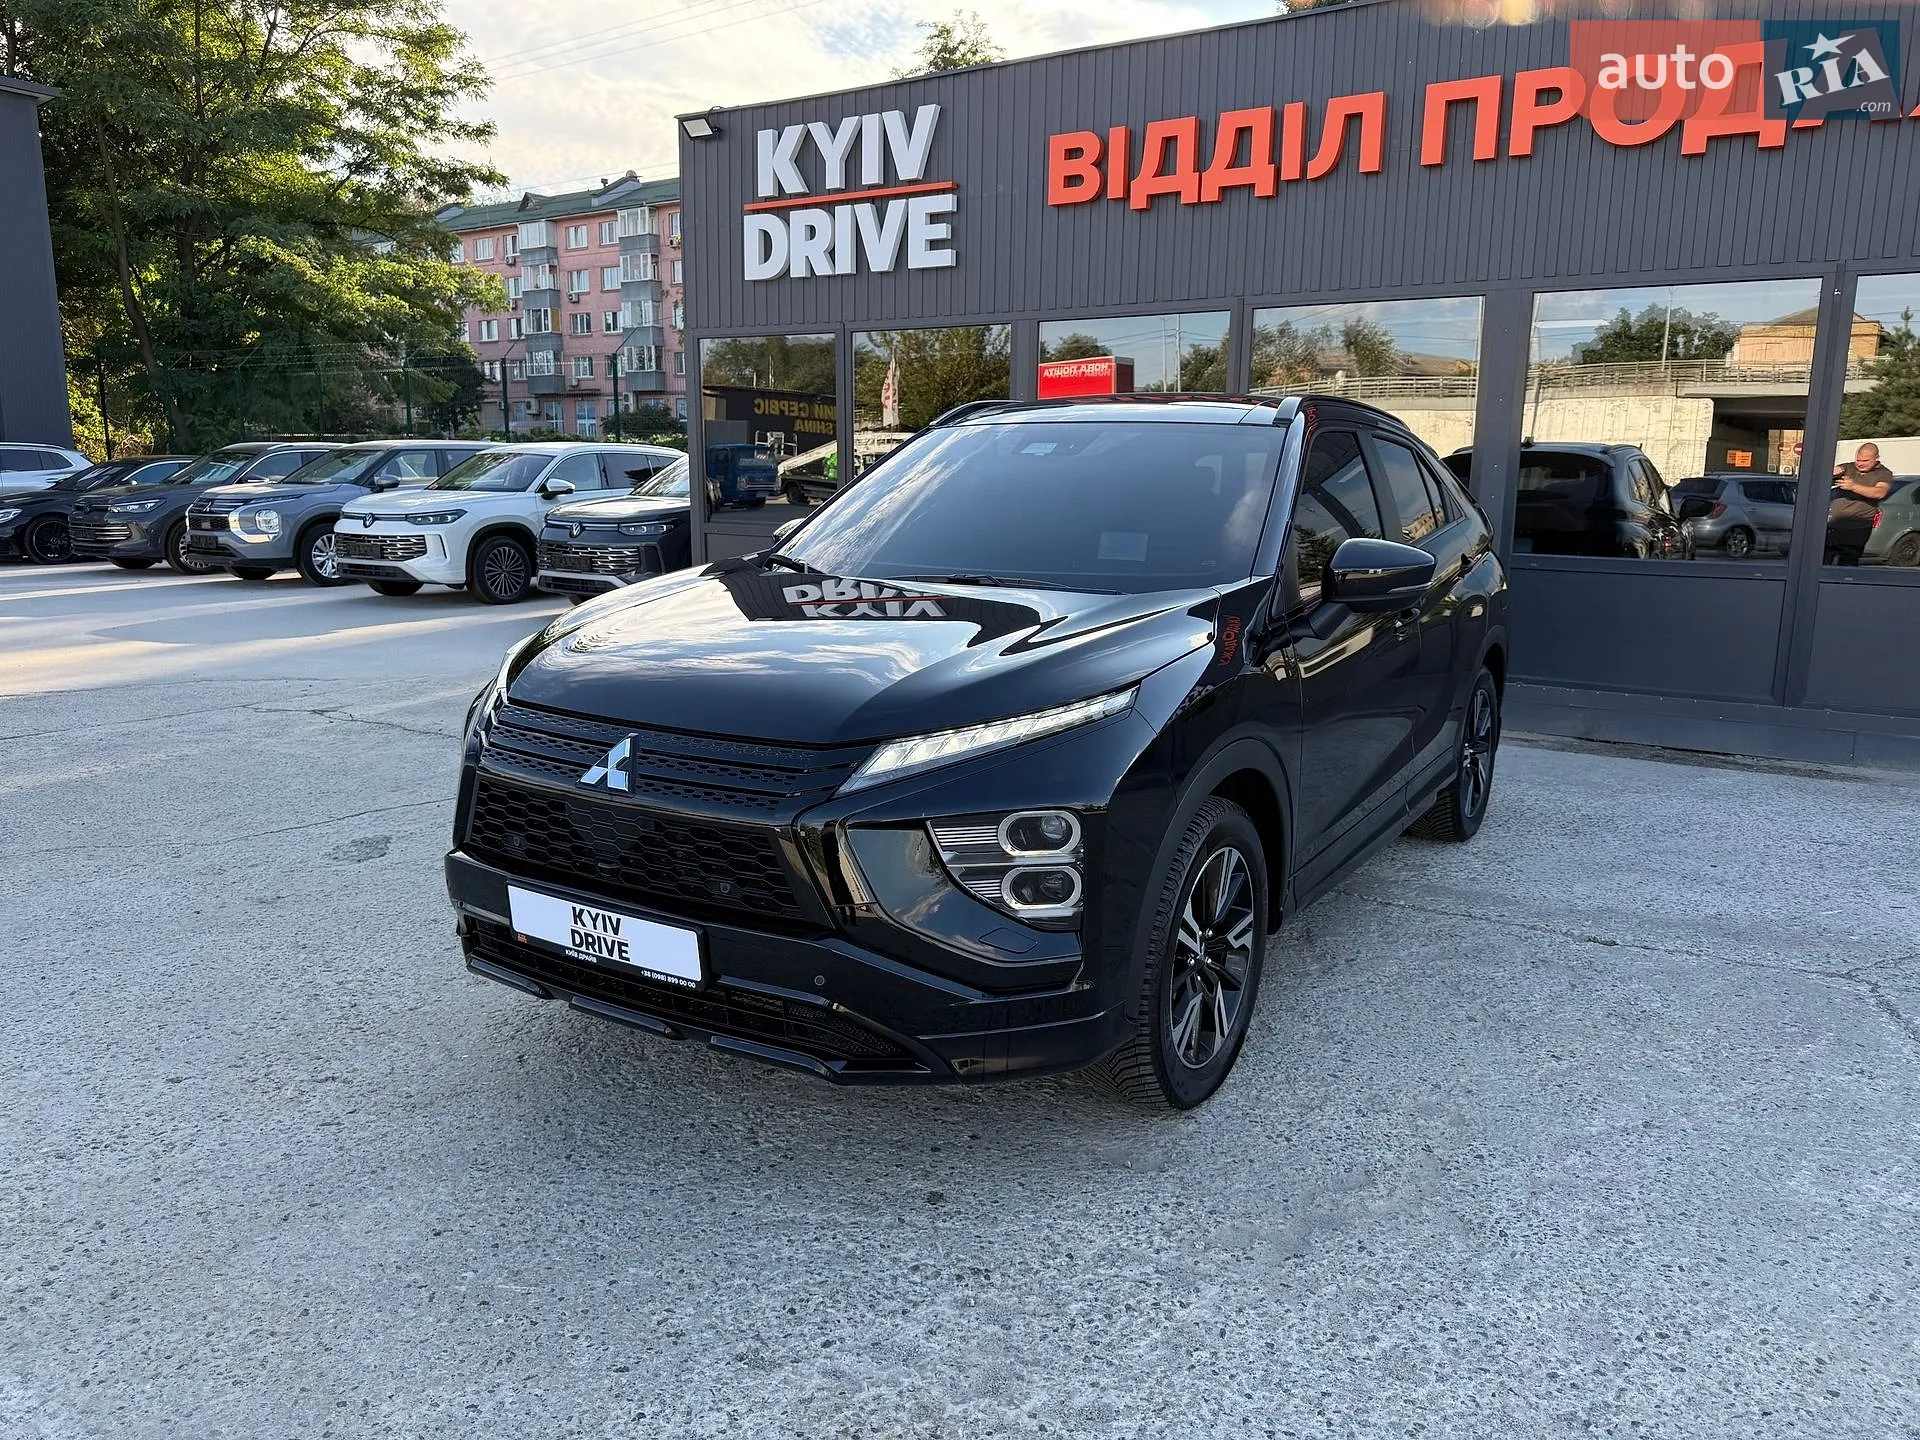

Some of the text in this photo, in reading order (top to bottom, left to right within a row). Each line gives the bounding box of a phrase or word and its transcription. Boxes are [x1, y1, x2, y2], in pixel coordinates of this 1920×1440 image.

[757, 104, 942, 197] KYIV
[1048, 27, 1920, 211] ВІДДІЛ ПРОДА
[743, 193, 957, 281] DRIVE
[570, 928, 631, 962] DRIVE
[571, 905, 622, 936] KYIV
